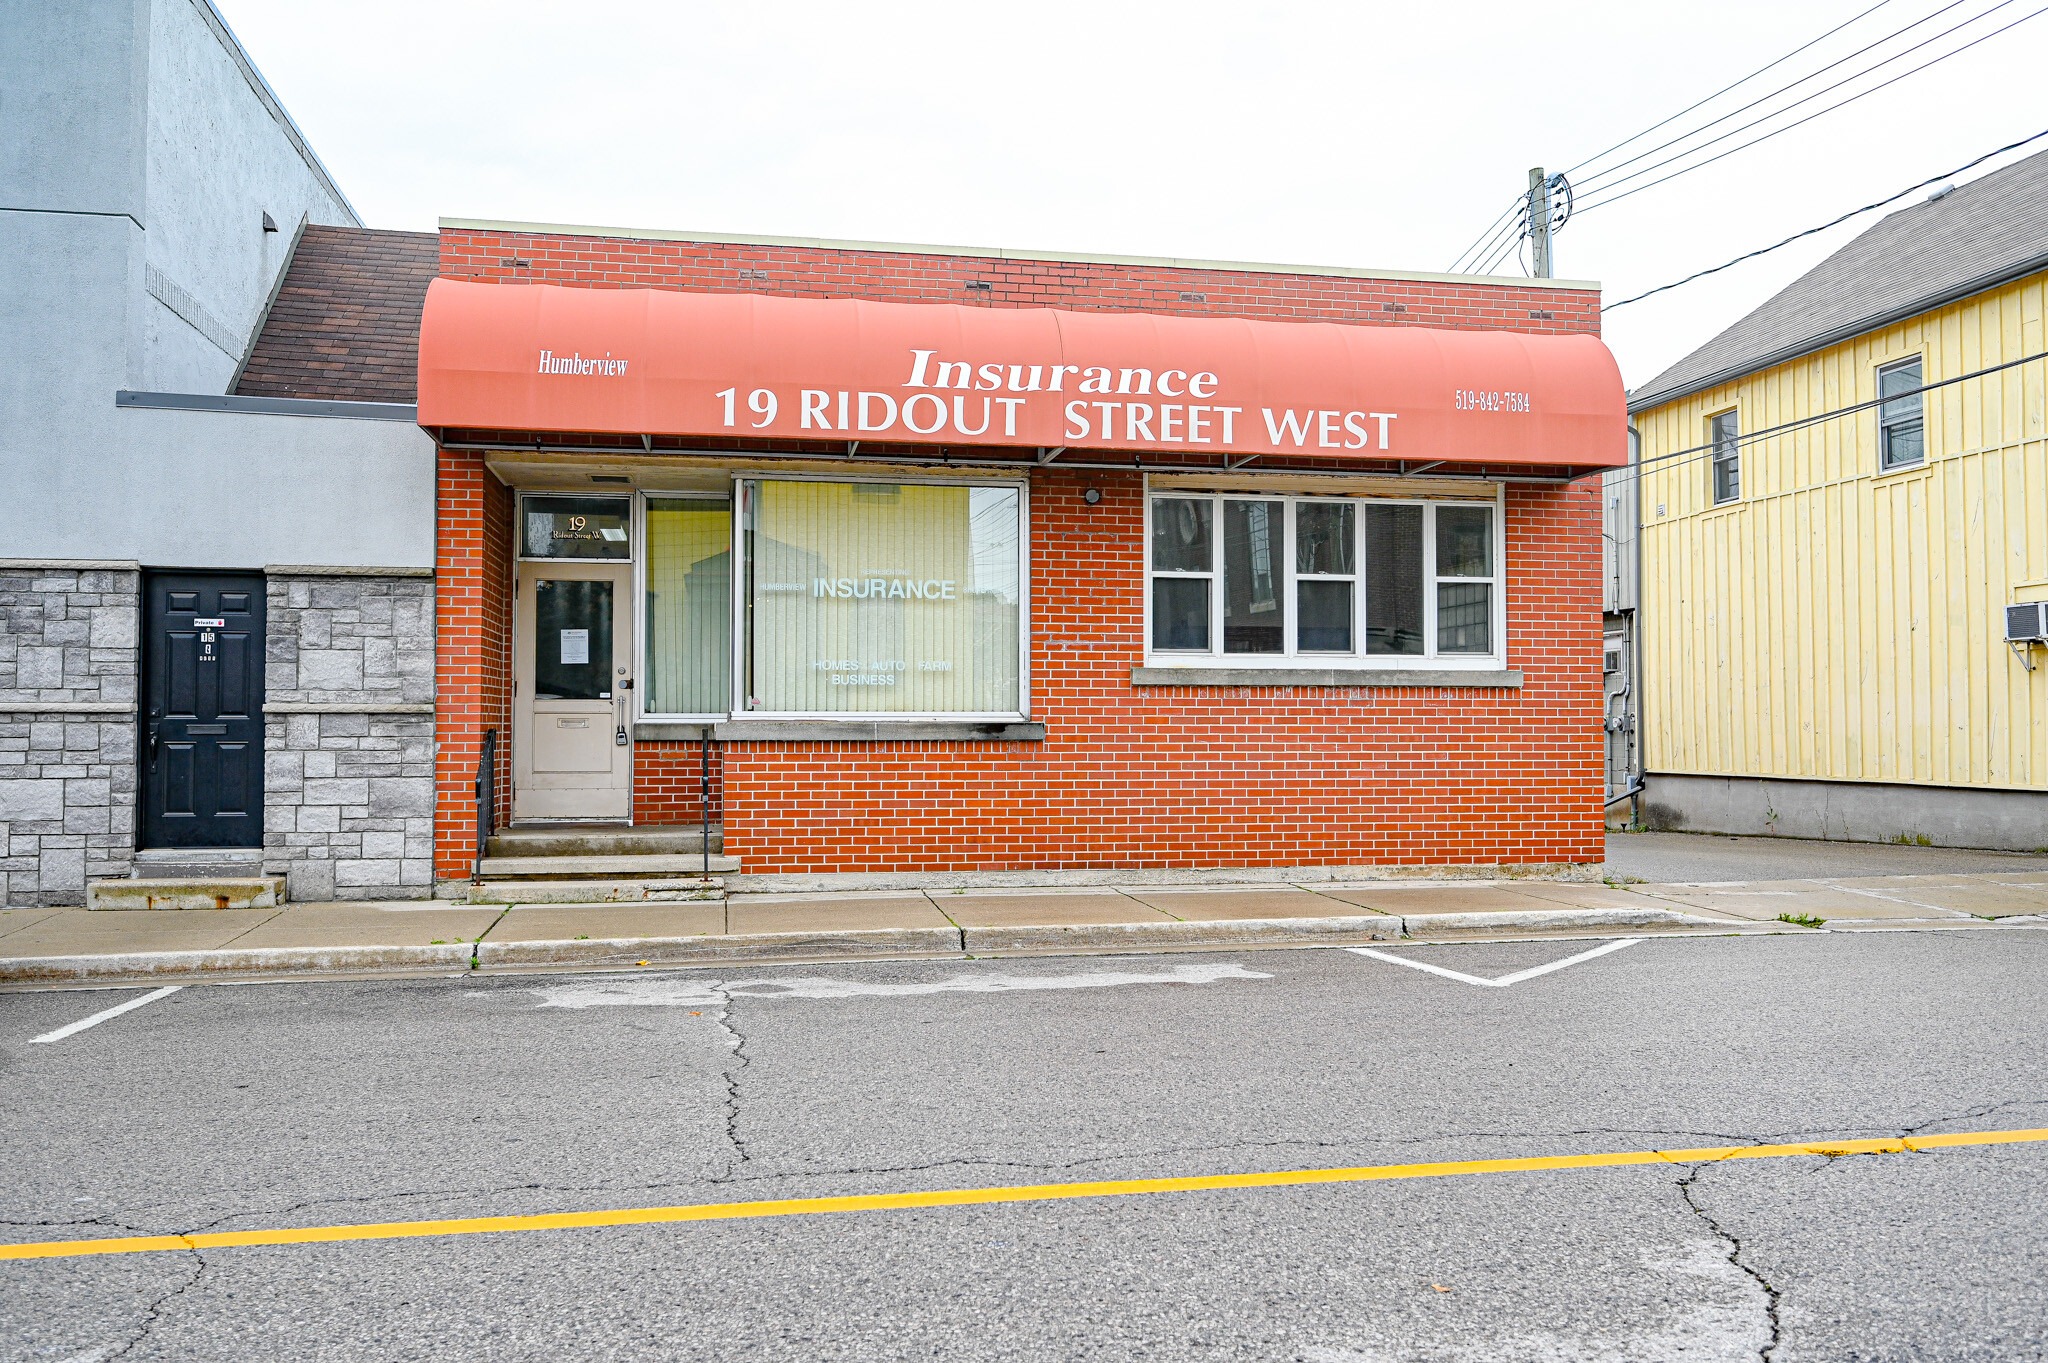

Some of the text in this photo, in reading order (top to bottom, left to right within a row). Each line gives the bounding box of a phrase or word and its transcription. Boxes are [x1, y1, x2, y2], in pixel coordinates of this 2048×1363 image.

[537, 349, 629, 377] Humberview
[901, 348, 1219, 399] Insurance
[1455, 389, 1531, 413] 519-842-7584
[714, 387, 1398, 450] 19 RIDOUT STREET WEST
[568, 516, 587, 532] 19
[760, 582, 807, 592] HUMBERVIEW
[813, 577, 956, 600] INSURANCE
[202, 633, 214, 642] 15
[812, 659, 953, 672] HOMES AUTO FARM
[831, 674, 896, 686] BUSINESS
